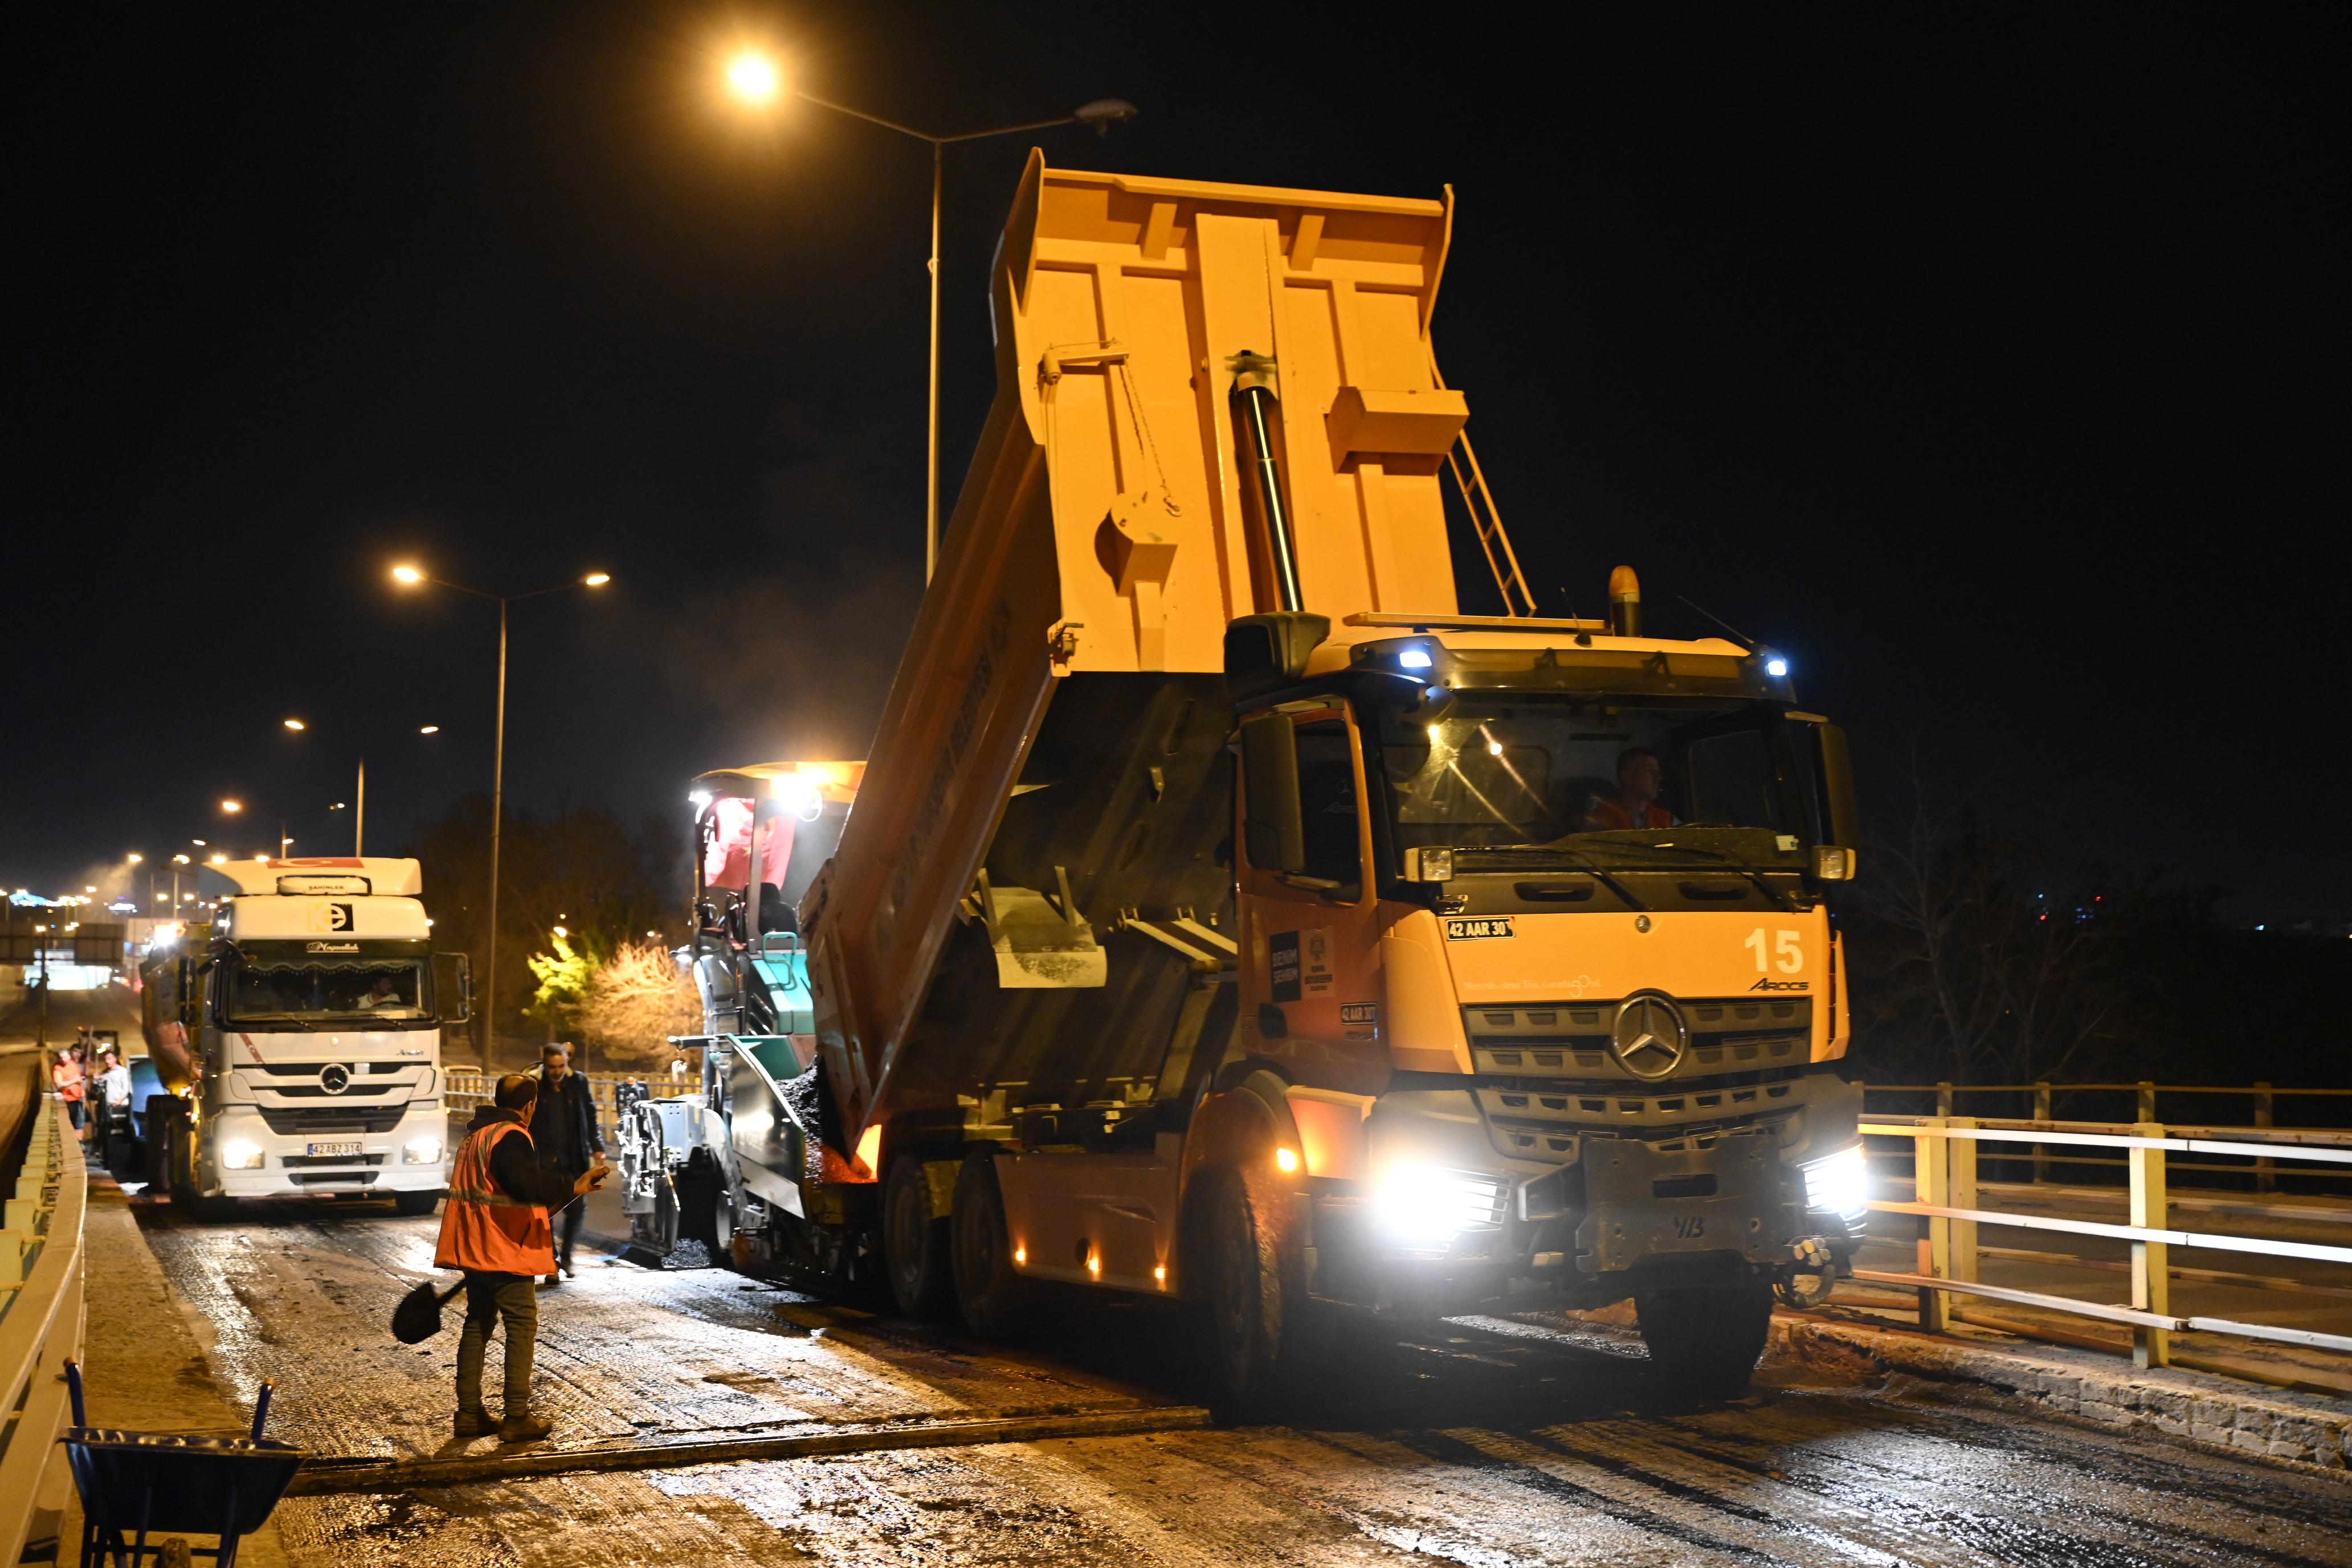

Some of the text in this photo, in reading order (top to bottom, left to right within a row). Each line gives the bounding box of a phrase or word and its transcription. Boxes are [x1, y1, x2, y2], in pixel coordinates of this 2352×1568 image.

[1449, 922, 1464, 937] 42
[1466, 922, 1491, 936] AAR
[1744, 928, 1804, 974] 15
[326, 1145, 342, 1153] ABZ
